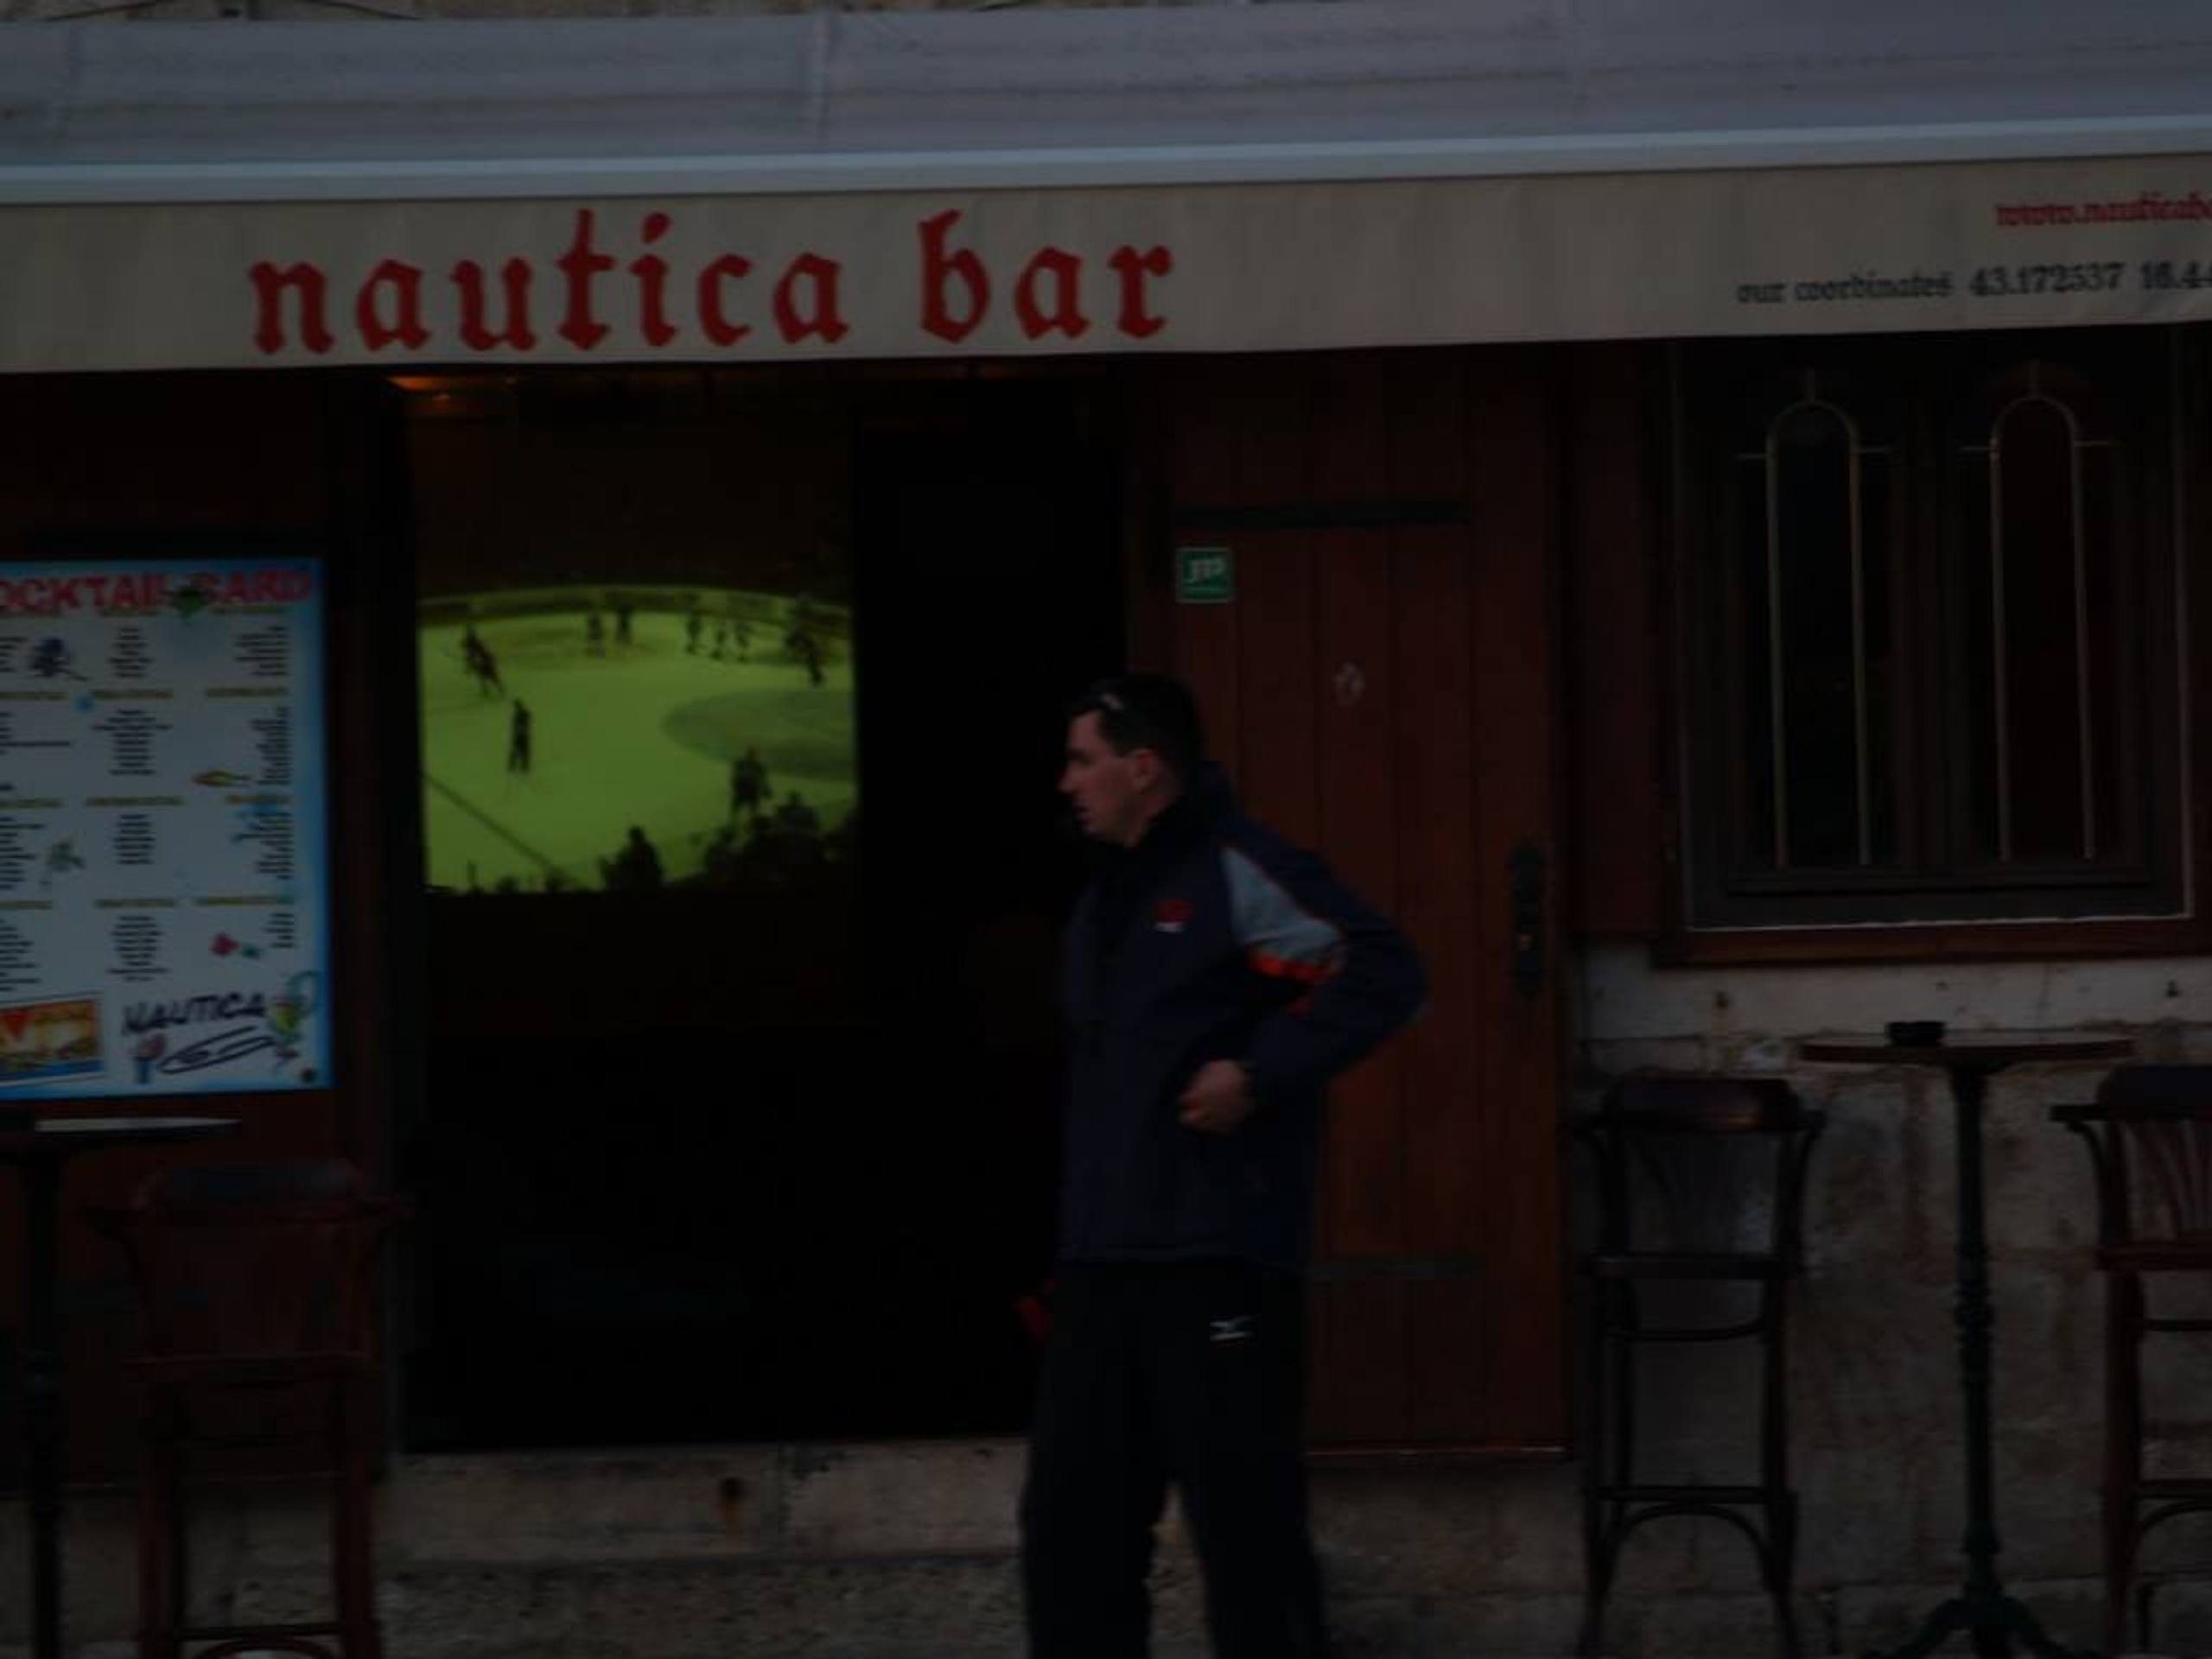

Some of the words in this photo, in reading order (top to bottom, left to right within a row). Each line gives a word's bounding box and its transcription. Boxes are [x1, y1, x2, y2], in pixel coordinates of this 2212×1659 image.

[250, 208, 849, 354] nautica
[918, 208, 1173, 343] bar
[1737, 283, 1786, 303] our
[1796, 267, 1953, 301] coordinates
[1970, 261, 2125, 296] 43.172537
[123, 991, 266, 1034] NAUTICA
